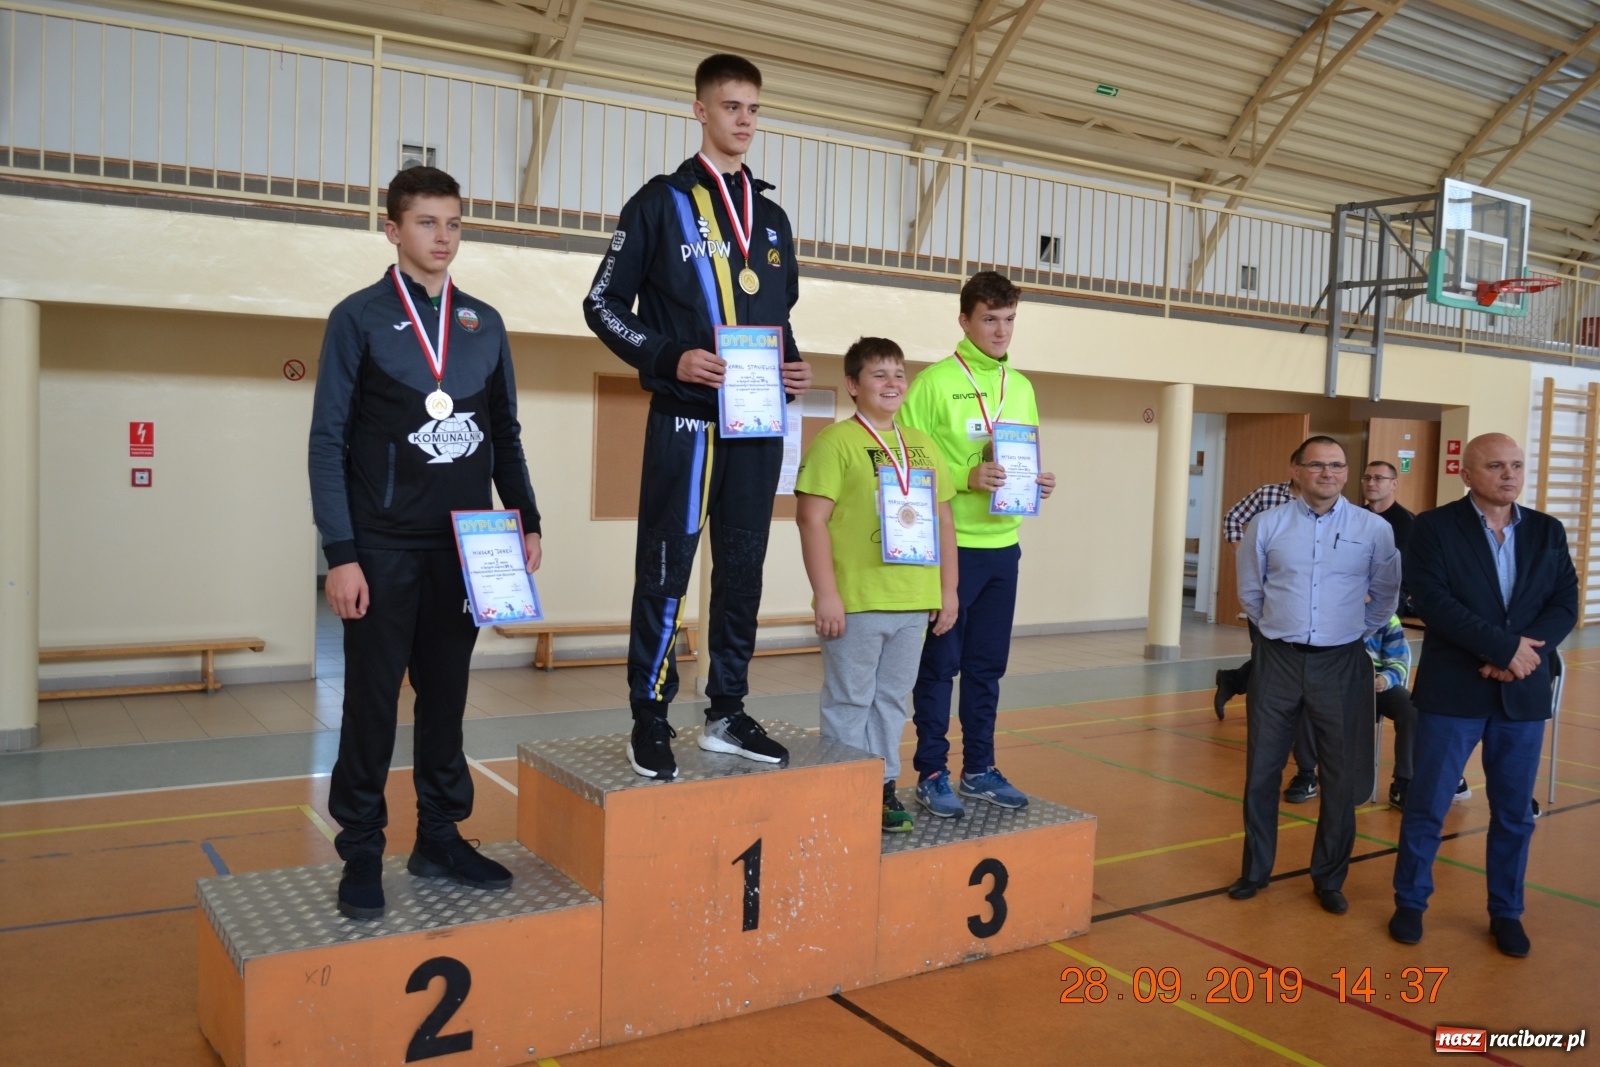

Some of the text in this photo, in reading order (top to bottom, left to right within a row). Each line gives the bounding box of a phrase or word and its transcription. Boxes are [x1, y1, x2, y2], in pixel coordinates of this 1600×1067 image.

[680, 241, 731, 262] PWPW
[720, 334, 778, 348] DYPLOM
[952, 392, 988, 400] GIVOA
[413, 431, 482, 443] KOMUNALNIK
[996, 429, 1037, 443] DYPLOM
[459, 518, 518, 533] DYPLOM
[731, 838, 763, 932] 1
[967, 858, 1009, 939] 3
[405, 956, 474, 1063] 2
